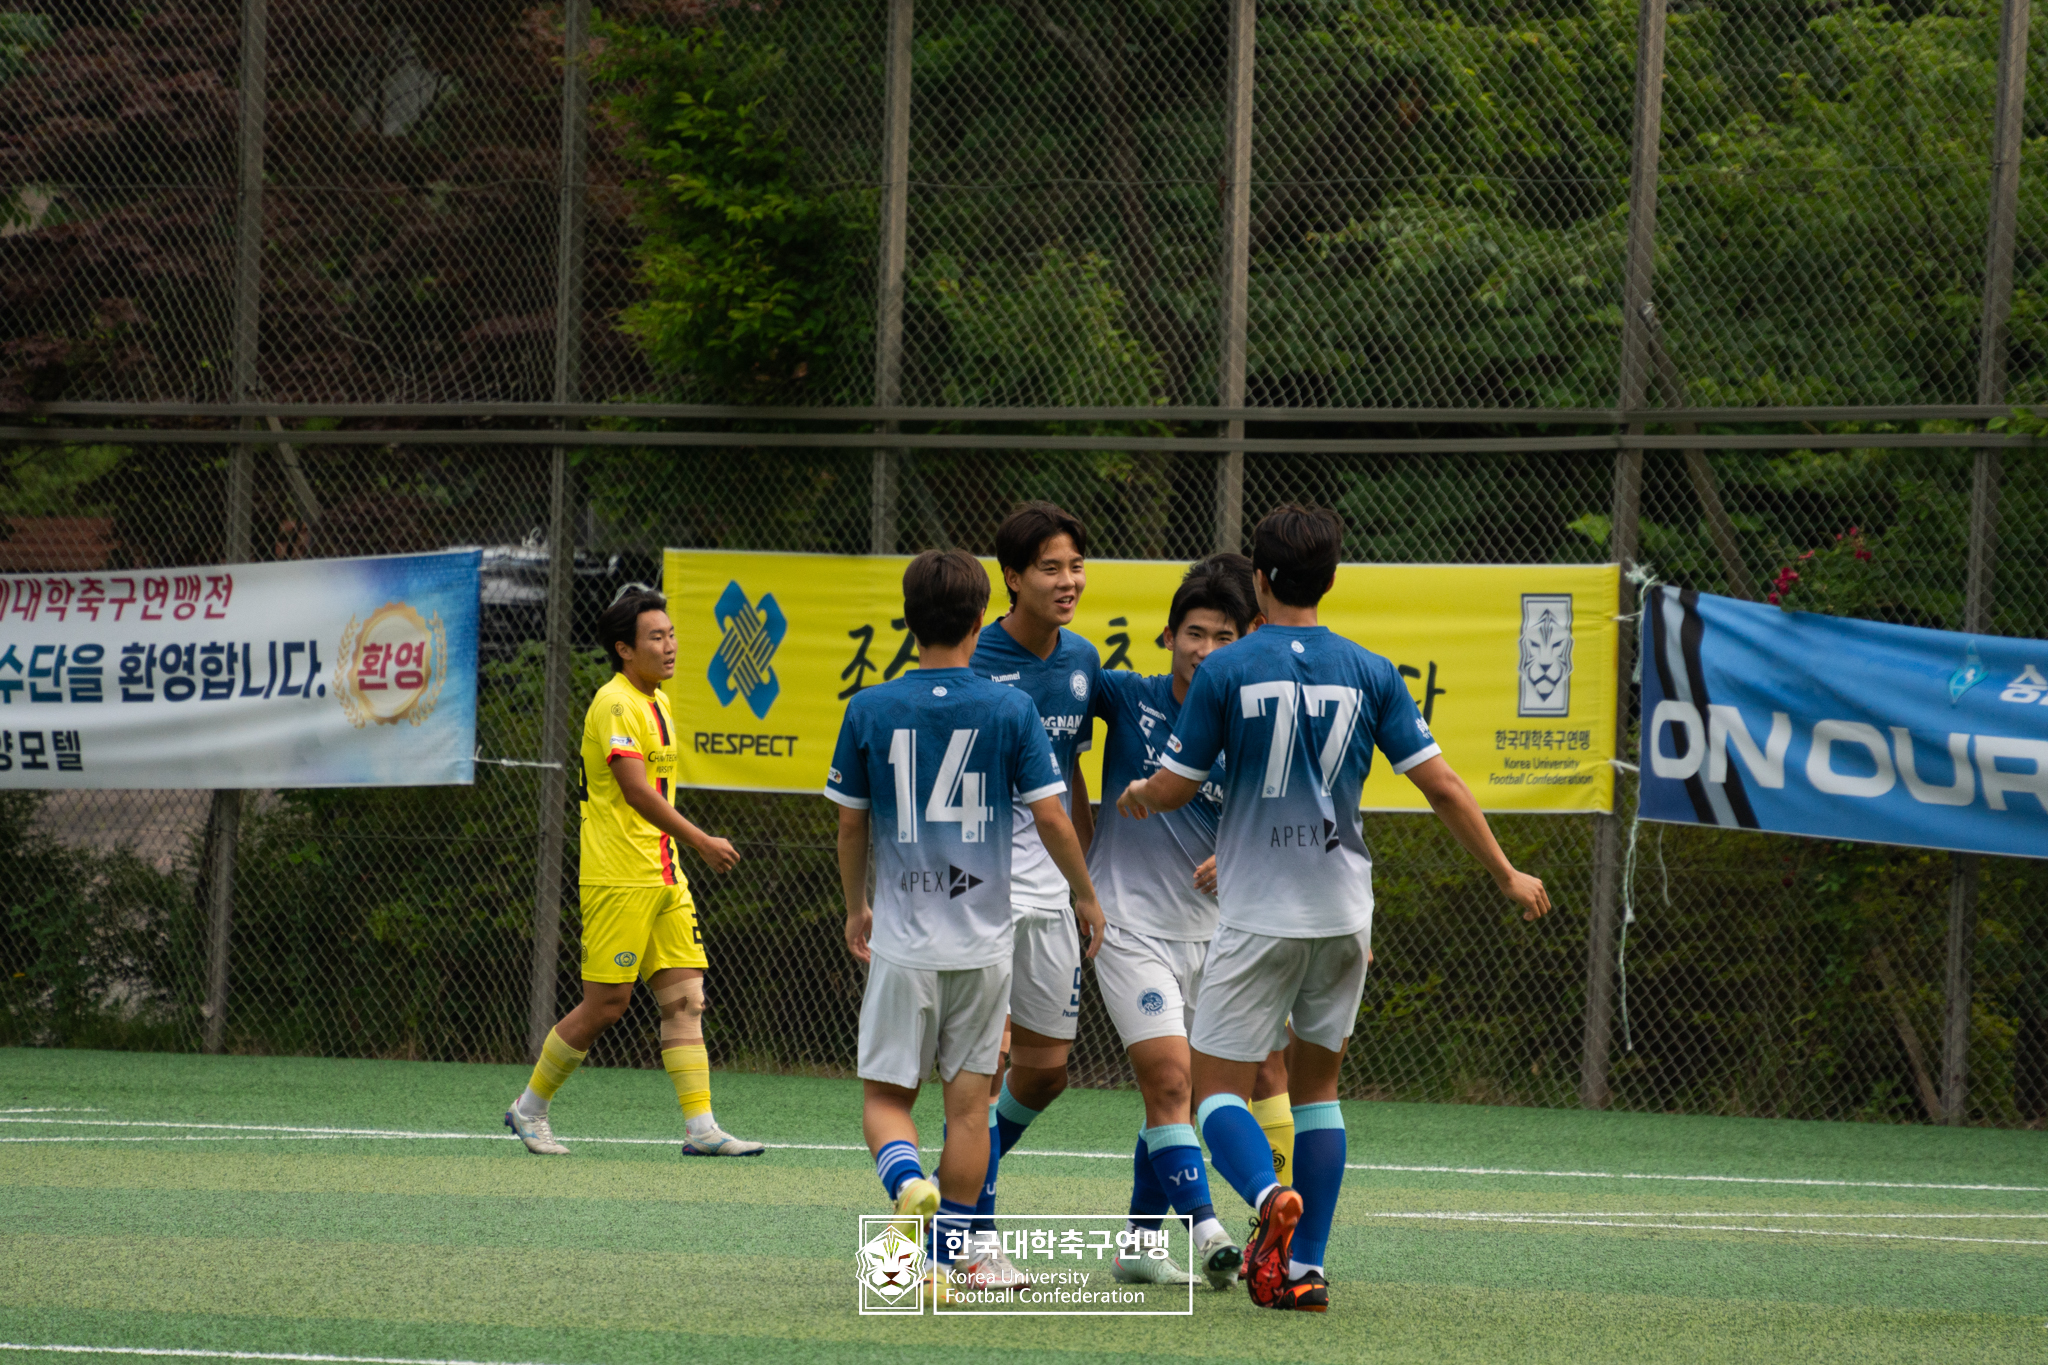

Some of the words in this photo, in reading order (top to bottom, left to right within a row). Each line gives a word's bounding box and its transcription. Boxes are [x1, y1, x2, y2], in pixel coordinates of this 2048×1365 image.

[118, 640, 326, 702] 환영합니다.
[357, 641, 425, 692] 환영
[990, 670, 1021, 683] hummel
[1040, 714, 1083, 729] GNAM
[694, 732, 798, 757] RESPECT
[1240, 680, 1363, 800] 77
[1494, 729, 1591, 751] 한국대학축구연맹
[1504, 757, 1531, 770] Korea
[1532, 757, 1581, 771] University
[1651, 700, 1792, 789] ON
[1806, 720, 2048, 819] OUR
[888, 729, 994, 843] 14
[1488, 773, 1525, 785] Football
[1525, 773, 1594, 785] Confederation
[1270, 825, 1320, 848] APEX
[901, 871, 944, 893] APEX
[1169, 1167, 1198, 1186] YU
